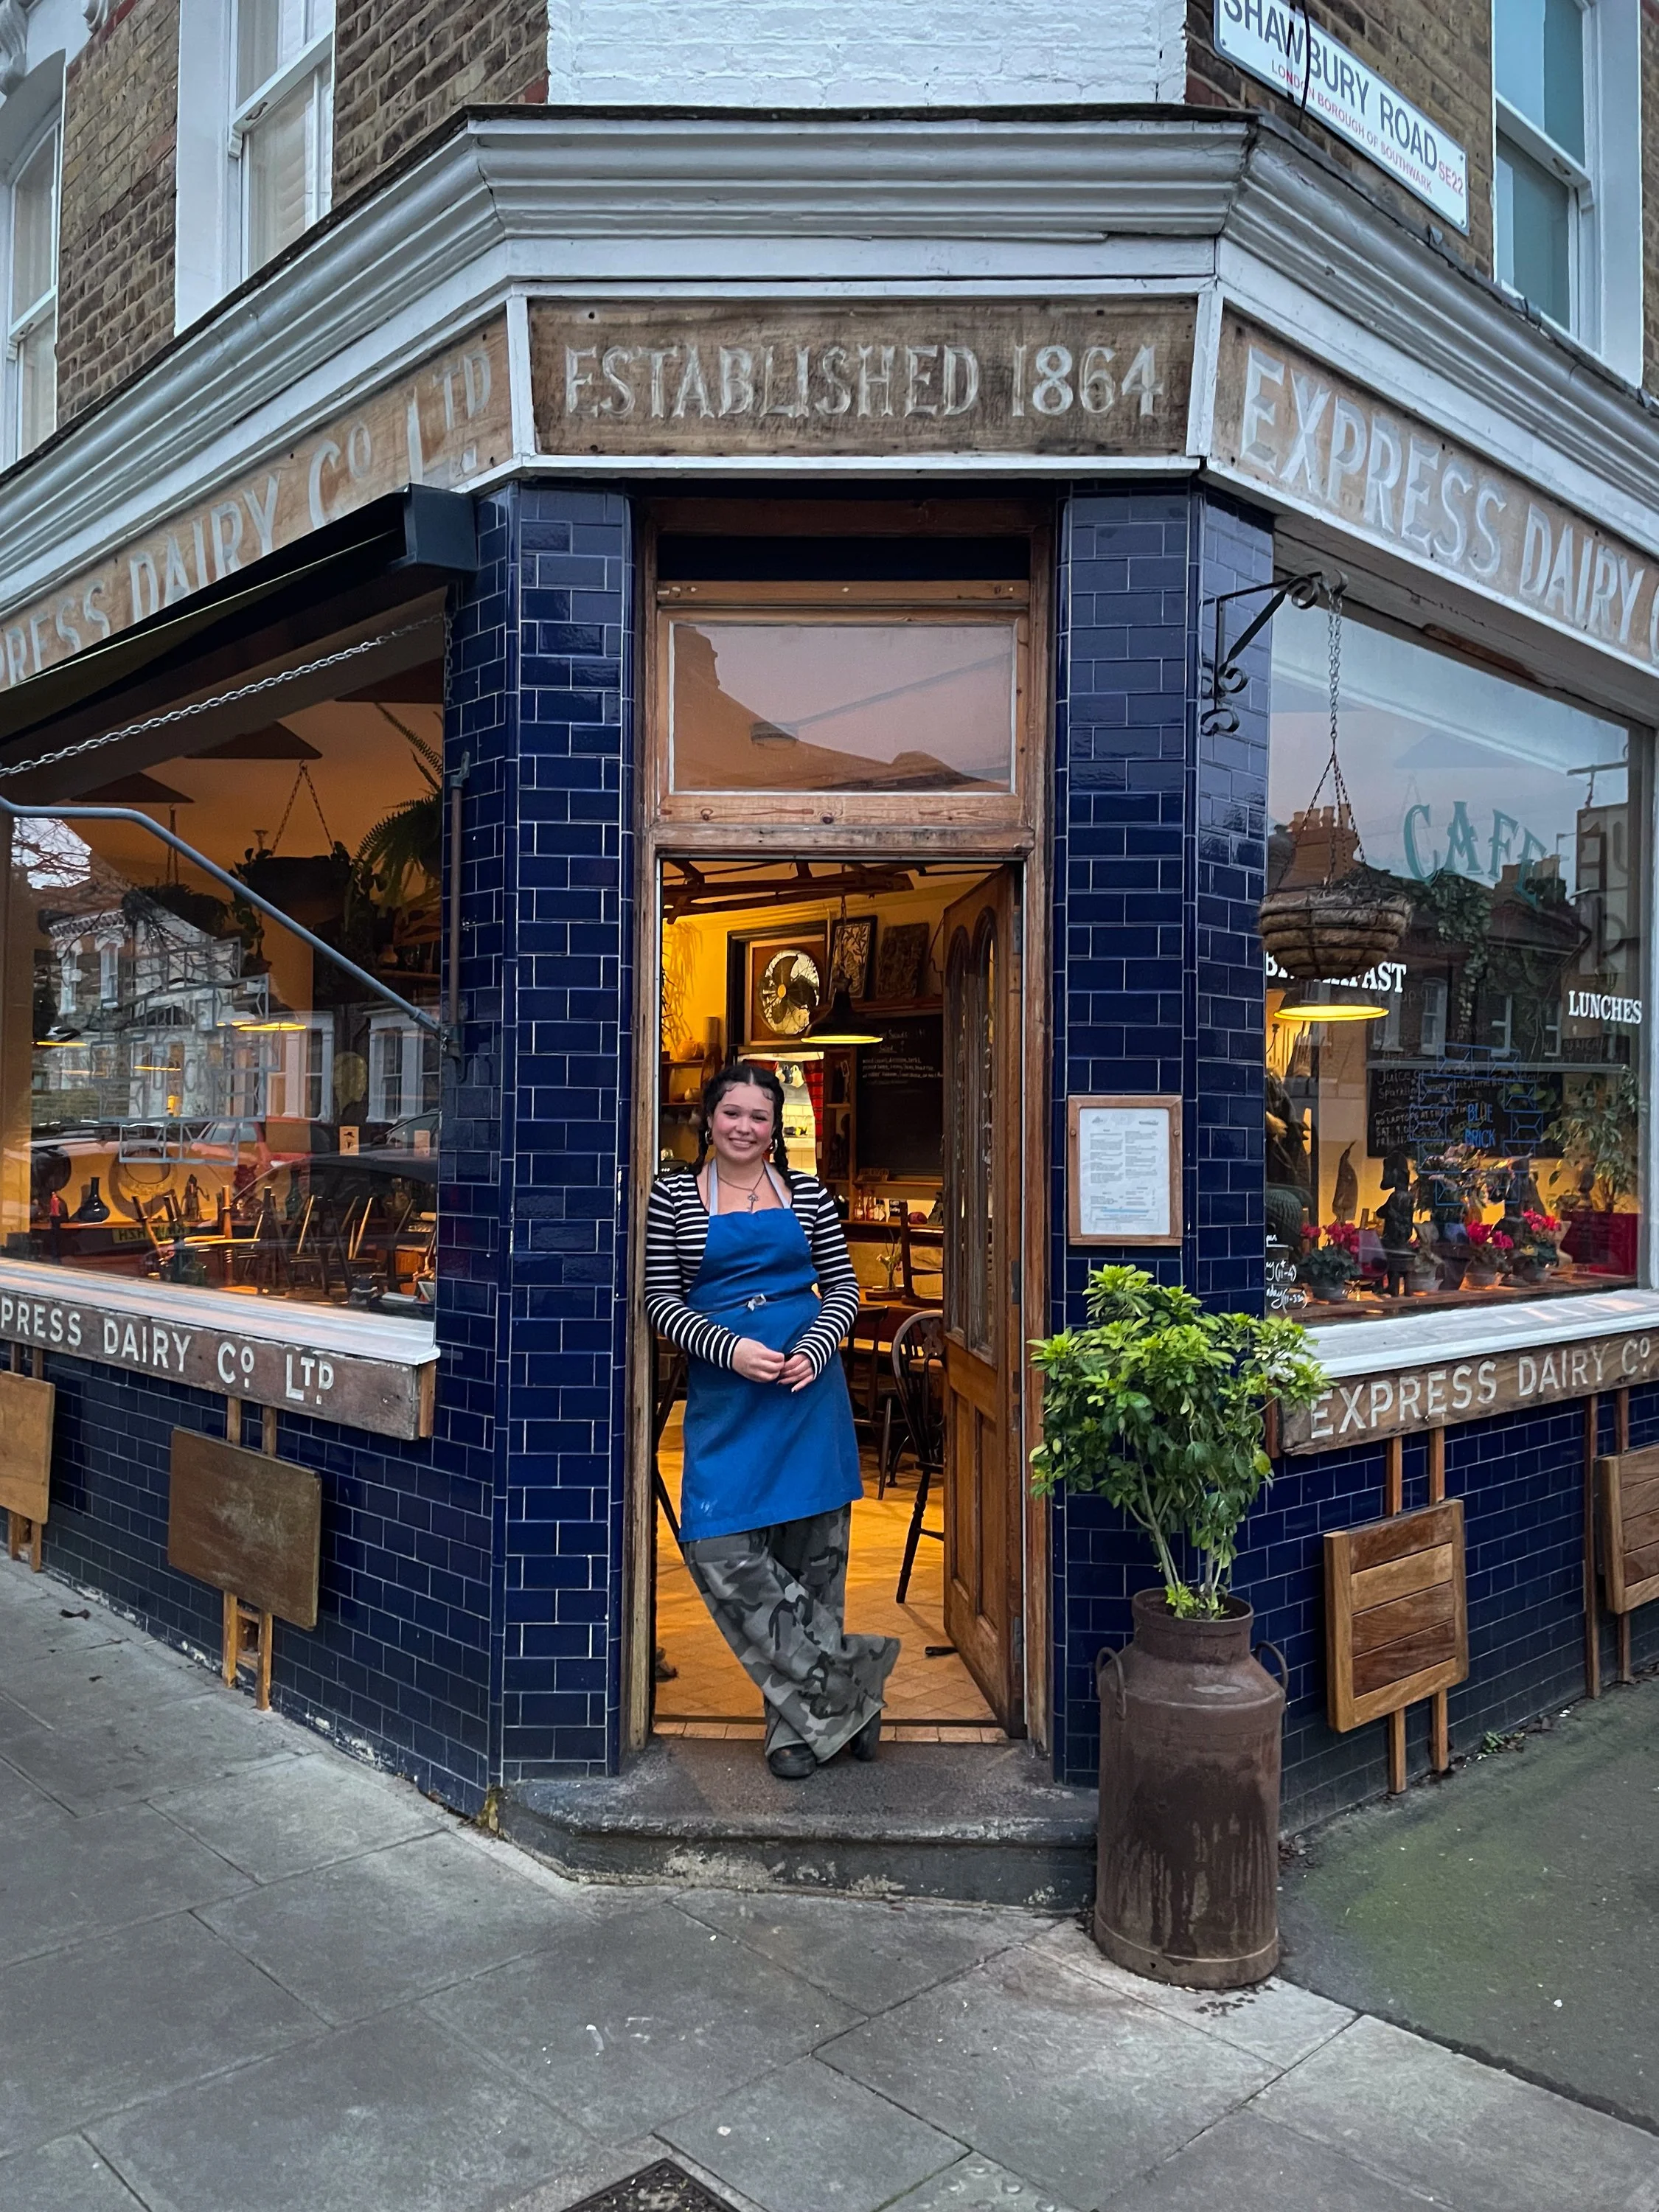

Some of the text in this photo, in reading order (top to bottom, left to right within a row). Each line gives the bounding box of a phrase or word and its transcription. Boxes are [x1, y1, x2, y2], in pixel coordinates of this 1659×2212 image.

[1272, 60, 1433, 194] LONDON BOROUGH OF SOUTHWARK
[1380, 91, 1437, 172] ROAD
[1439, 160, 1464, 198] SE22
[565, 343, 1166, 420] ESTABLISHED 1864
[1240, 344, 1507, 579] EXPRESS
[1518, 502, 1646, 644] DAIRY
[0, 579, 110, 686] RESS
[128, 470, 281, 625] DAIRY
[1403, 801, 1548, 908] CAFE
[1568, 990, 1643, 1025] LUNCHES
[1464, 1128, 1497, 1149] BRICK
[1467, 1102, 1494, 1124] BLUE
[0, 1297, 83, 1346] PRESS
[102, 1317, 192, 1373] DAIRY
[1310, 1360, 1498, 1439] EXPRESS
[1517, 1343, 1610, 1397] DAIRY
